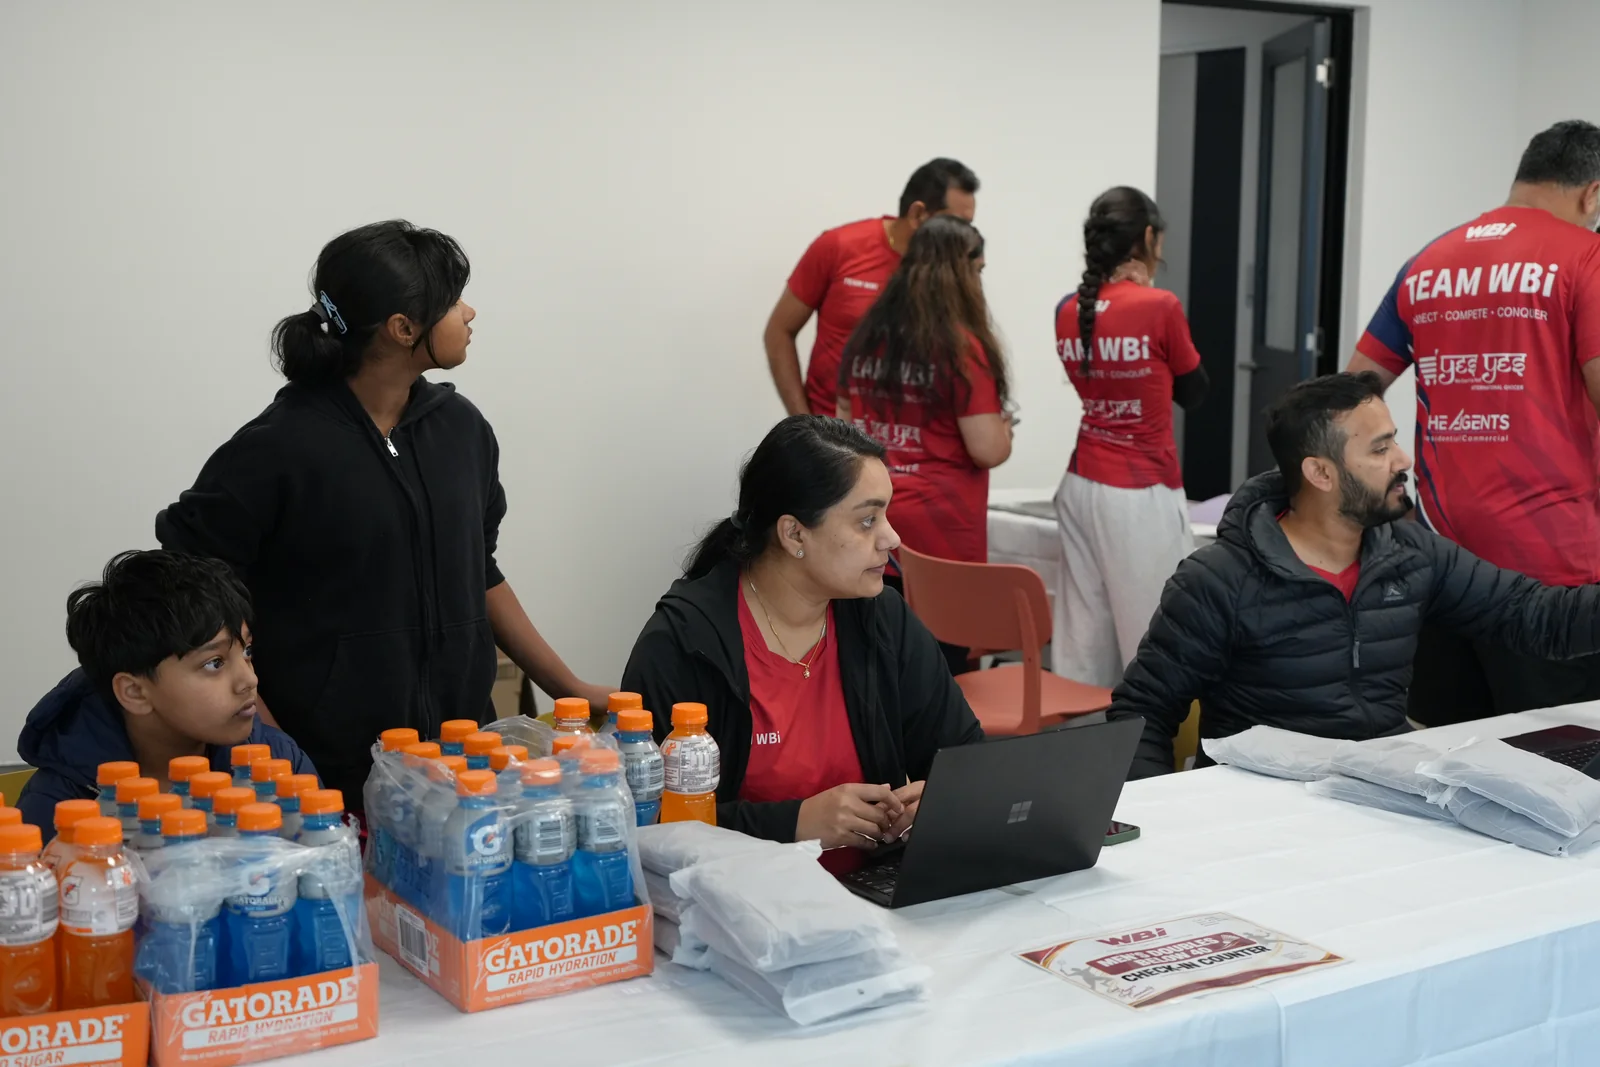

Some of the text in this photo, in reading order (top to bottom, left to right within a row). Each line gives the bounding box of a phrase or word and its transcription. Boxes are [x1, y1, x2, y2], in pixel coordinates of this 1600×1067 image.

[1405, 262, 1559, 306] TEAM WBi
[1445, 308, 1488, 321] COMPETE
[1497, 306, 1548, 321] CONQUER
[1098, 335, 1150, 361] WBi
[756, 730, 781, 745] WBi
[485, 920, 637, 973] GATORADE
[1137, 948, 1213, 967] BELOW 40
[1151, 937, 1220, 959] DOUBLES
[508, 966, 544, 985] RAPID
[549, 952, 616, 976] HYDRATION
[1121, 961, 1199, 982] CHECK-IN
[1200, 945, 1272, 965] COUNTER
[182, 976, 358, 1028] GATORADE
[0, 1015, 123, 1053] ORADE
[208, 1026, 249, 1043] RAPID
